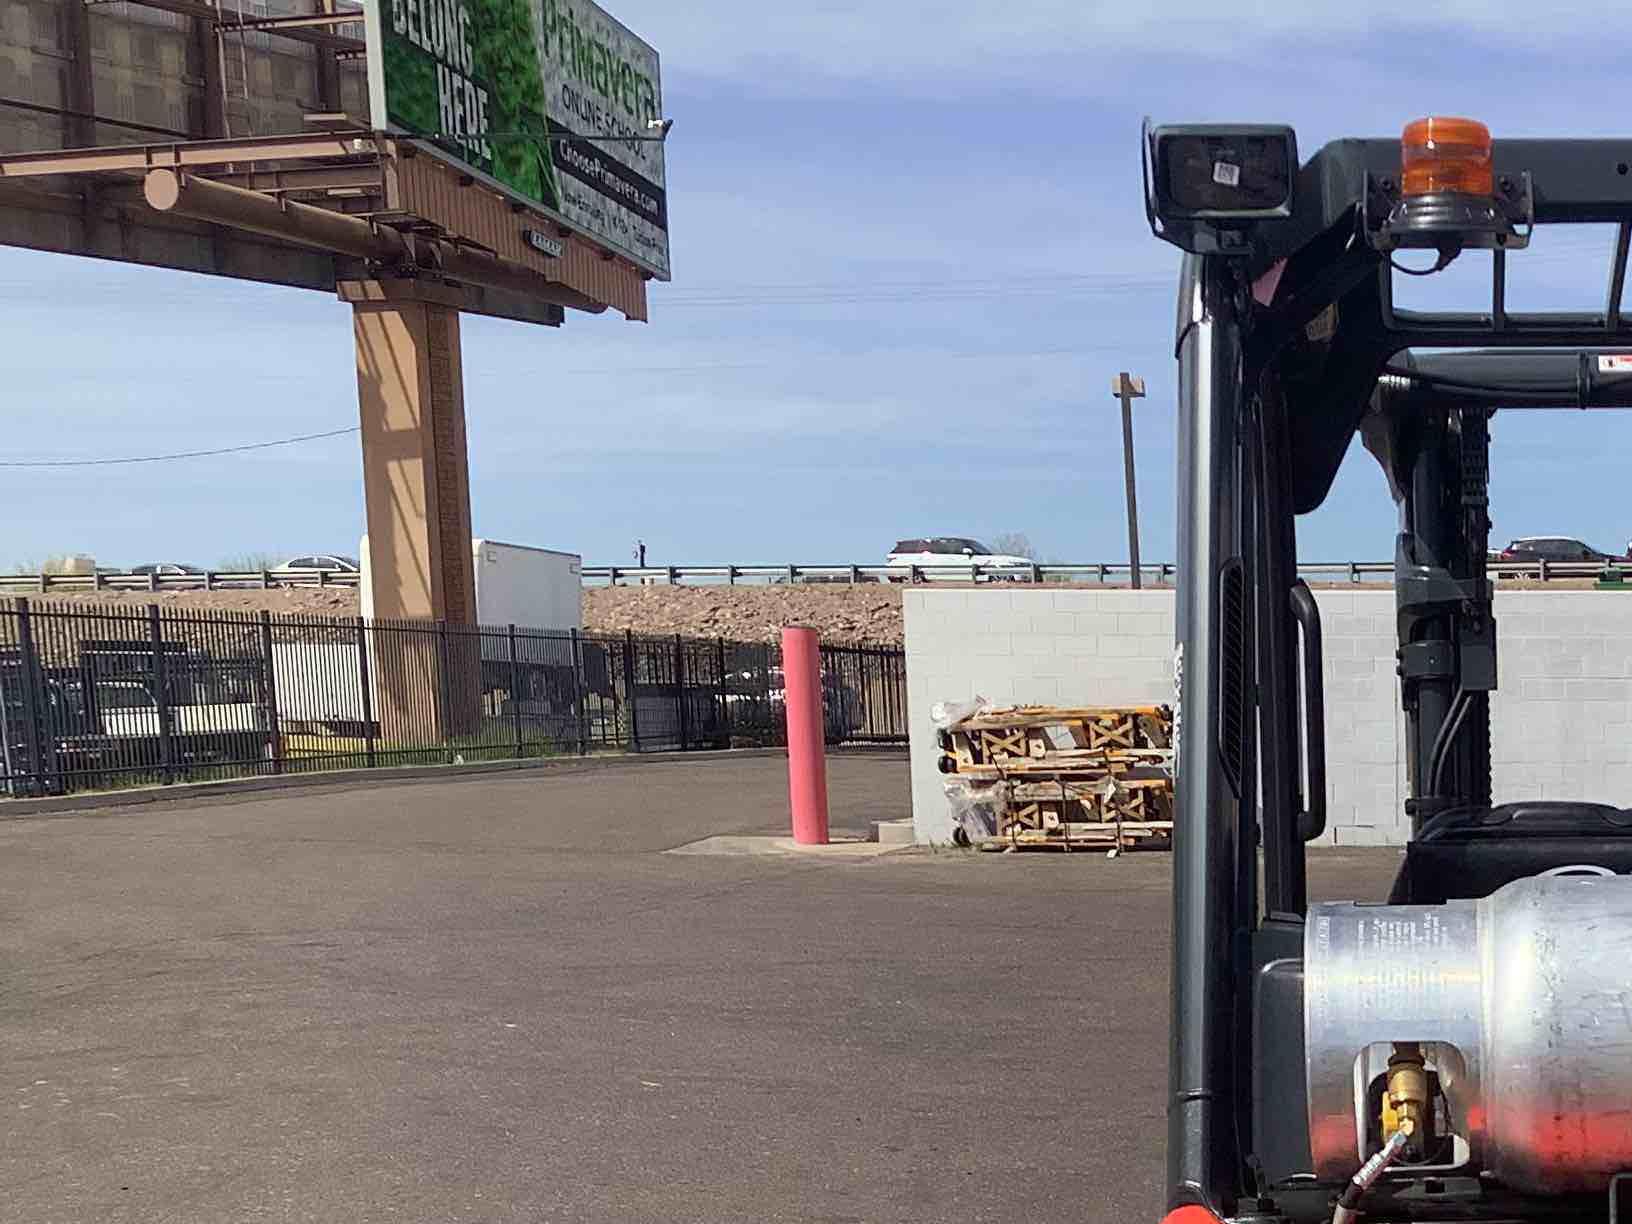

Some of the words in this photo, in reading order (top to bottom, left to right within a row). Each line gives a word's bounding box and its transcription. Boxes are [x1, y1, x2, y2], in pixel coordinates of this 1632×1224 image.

[543, 0, 658, 127] Primavera
[562, 83, 602, 131] ONLINE
[601, 110, 647, 161] SCHOOL
[558, 138, 659, 217] ChoosePrimavera.com
